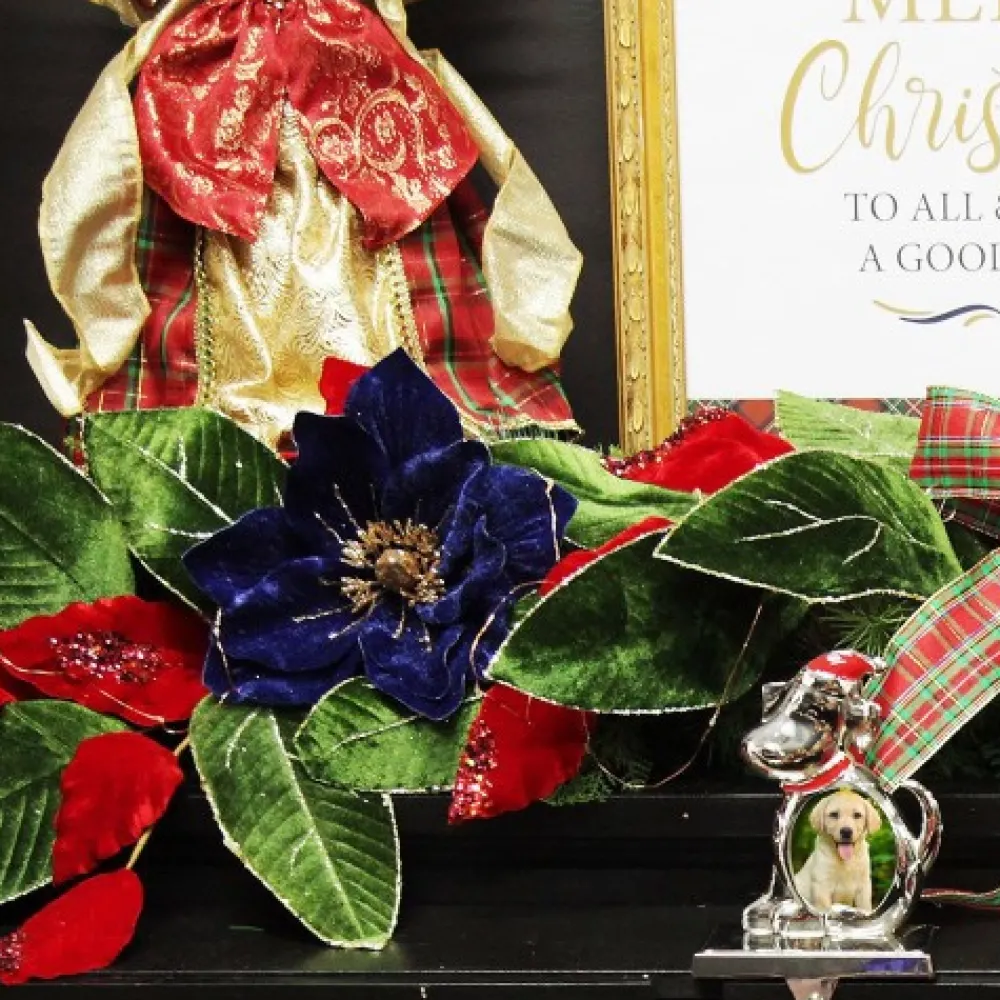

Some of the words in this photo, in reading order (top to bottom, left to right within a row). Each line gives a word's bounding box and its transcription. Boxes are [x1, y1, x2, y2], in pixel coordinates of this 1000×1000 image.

[844, 192, 897, 221] TO
[912, 192, 981, 221] ALL
[859, 243, 883, 272] A
